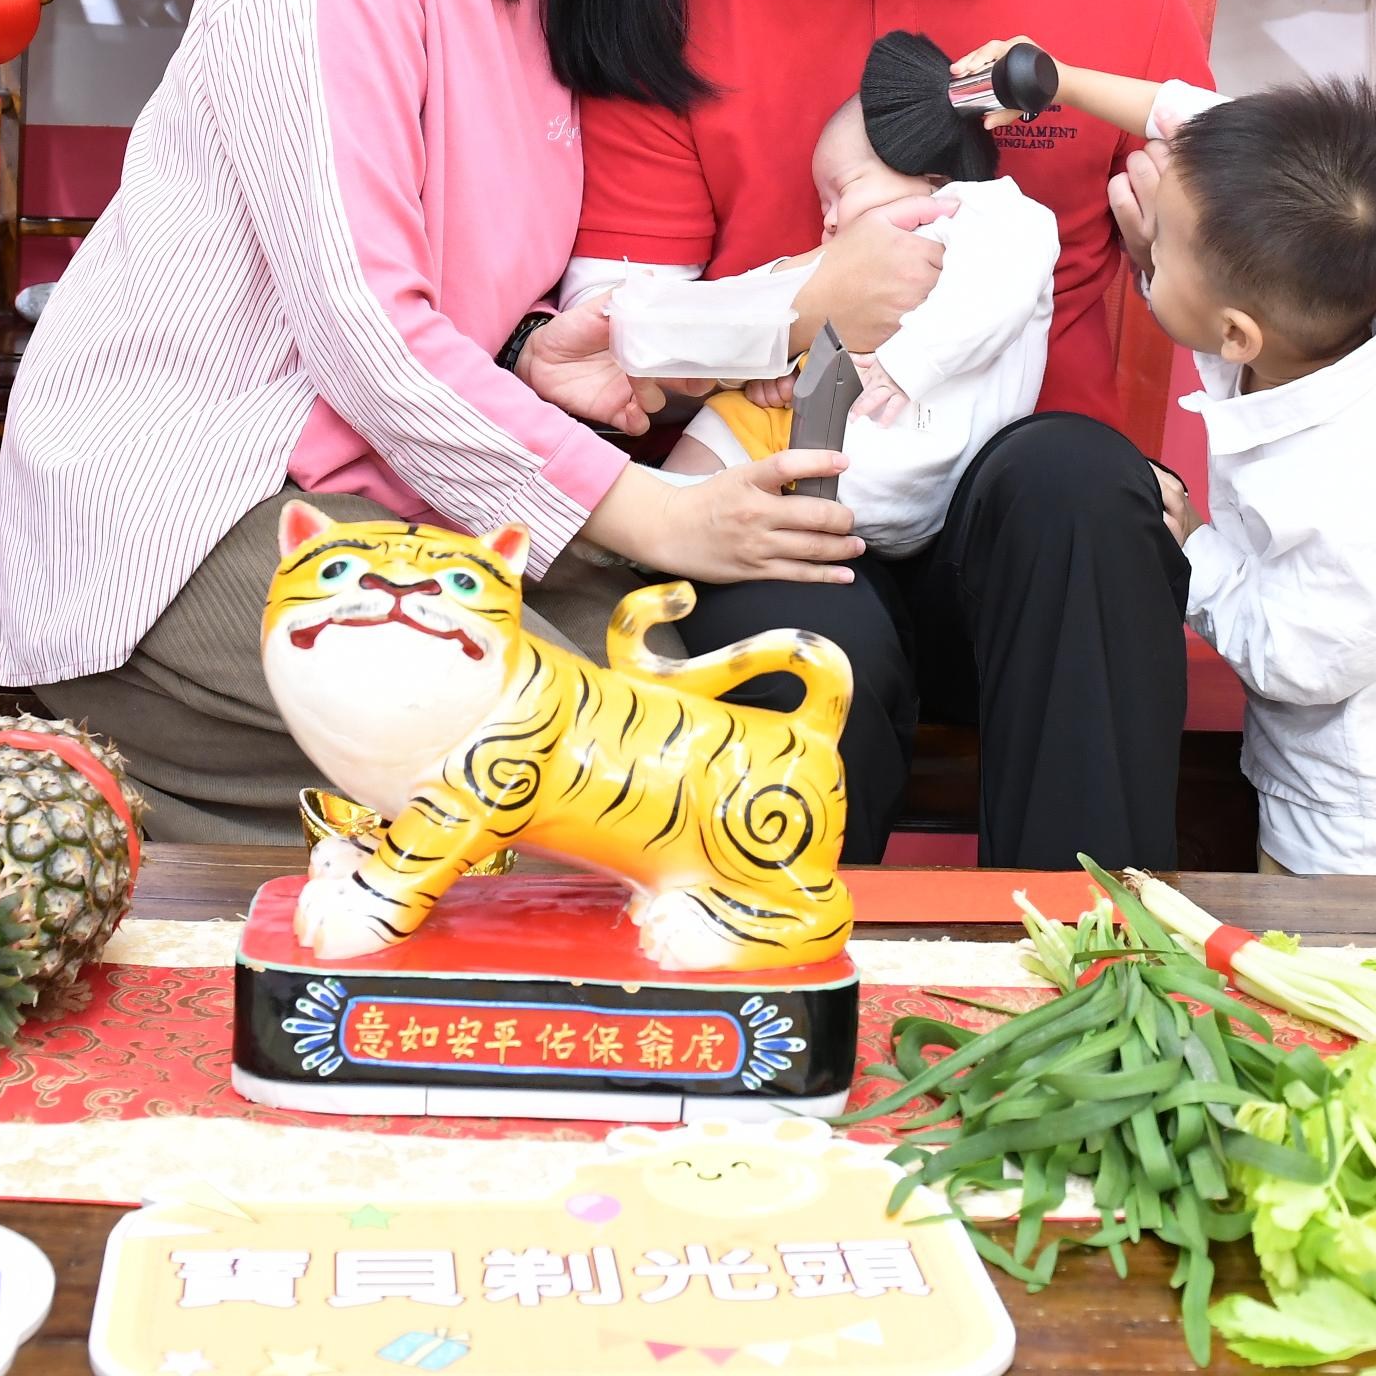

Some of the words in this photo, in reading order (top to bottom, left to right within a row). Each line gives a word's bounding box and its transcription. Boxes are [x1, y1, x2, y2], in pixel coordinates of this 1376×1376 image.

[995, 125, 1077, 139] URNAMENT
[170, 1240, 934, 1308] 寶貝剃光頭
